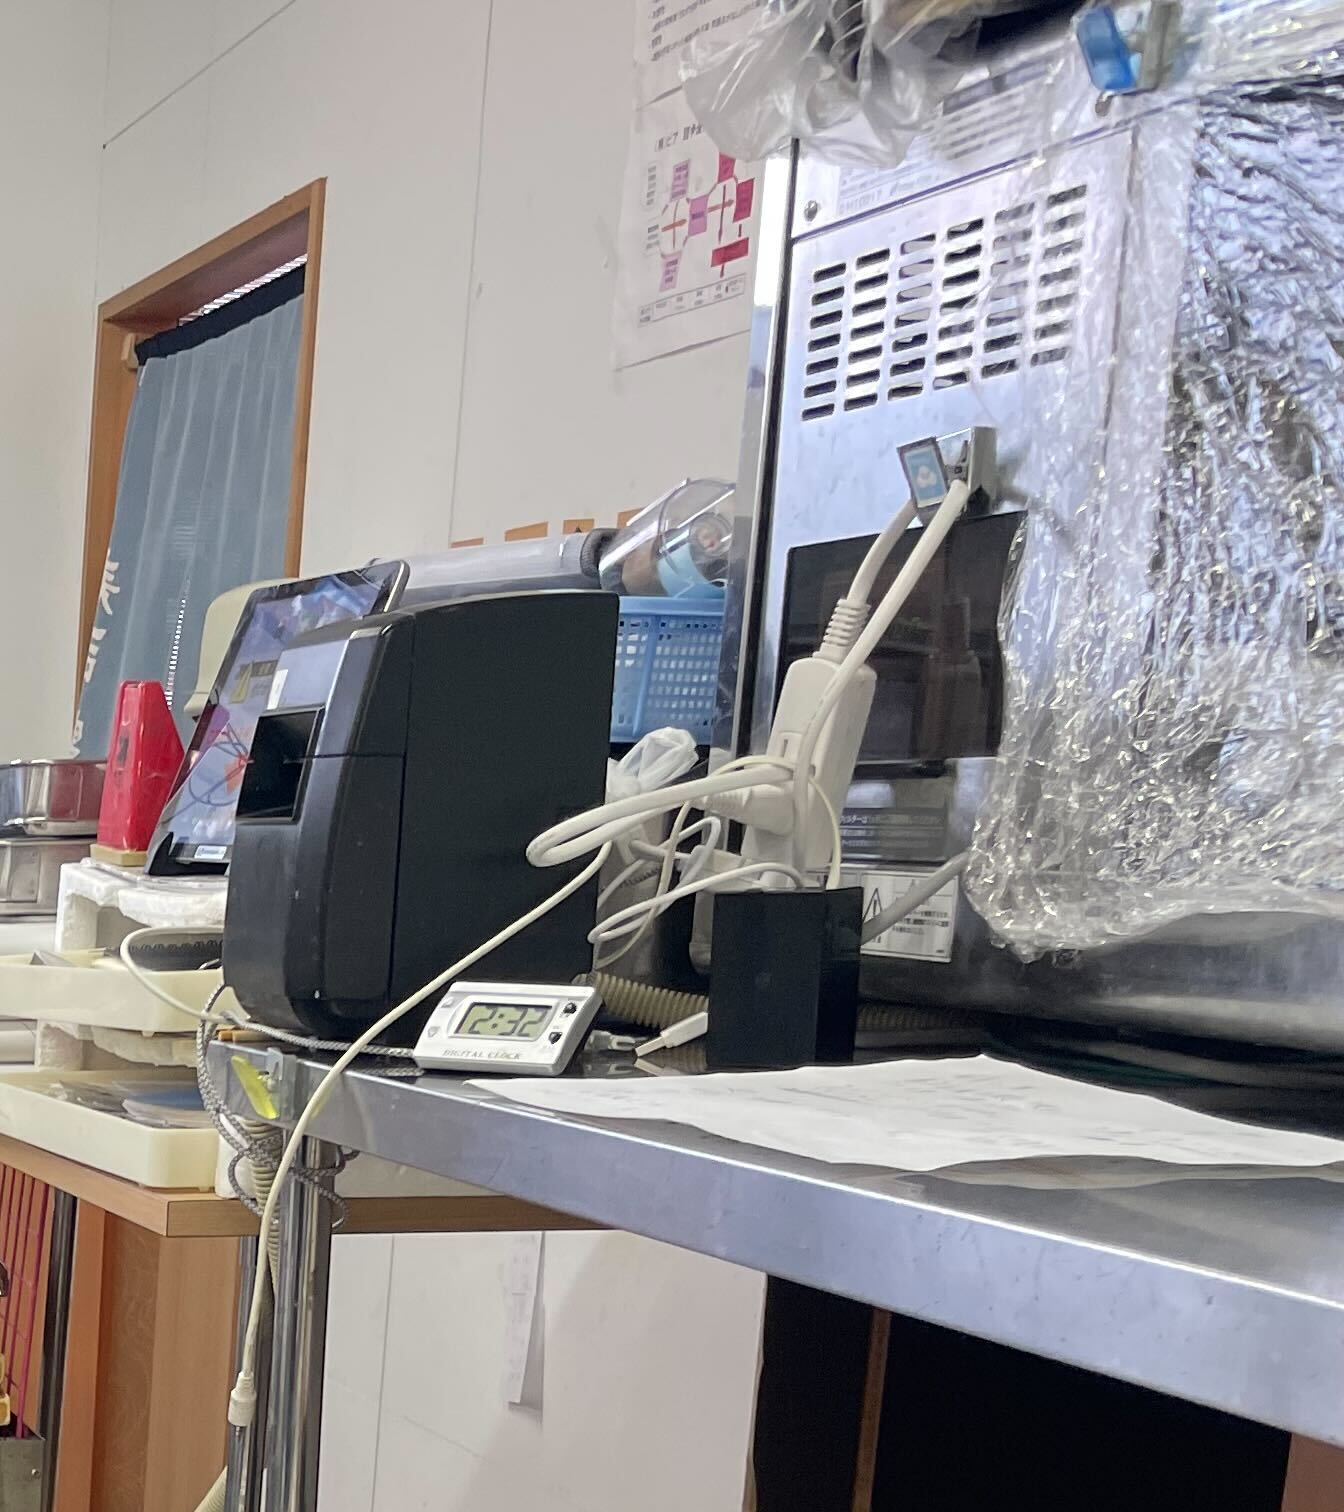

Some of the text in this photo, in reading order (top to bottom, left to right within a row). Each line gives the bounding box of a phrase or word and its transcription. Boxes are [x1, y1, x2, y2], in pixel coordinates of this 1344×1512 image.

[468, 1005, 548, 1037] 2:32
[441, 1048, 523, 1061] DIGITAL CLOCK
